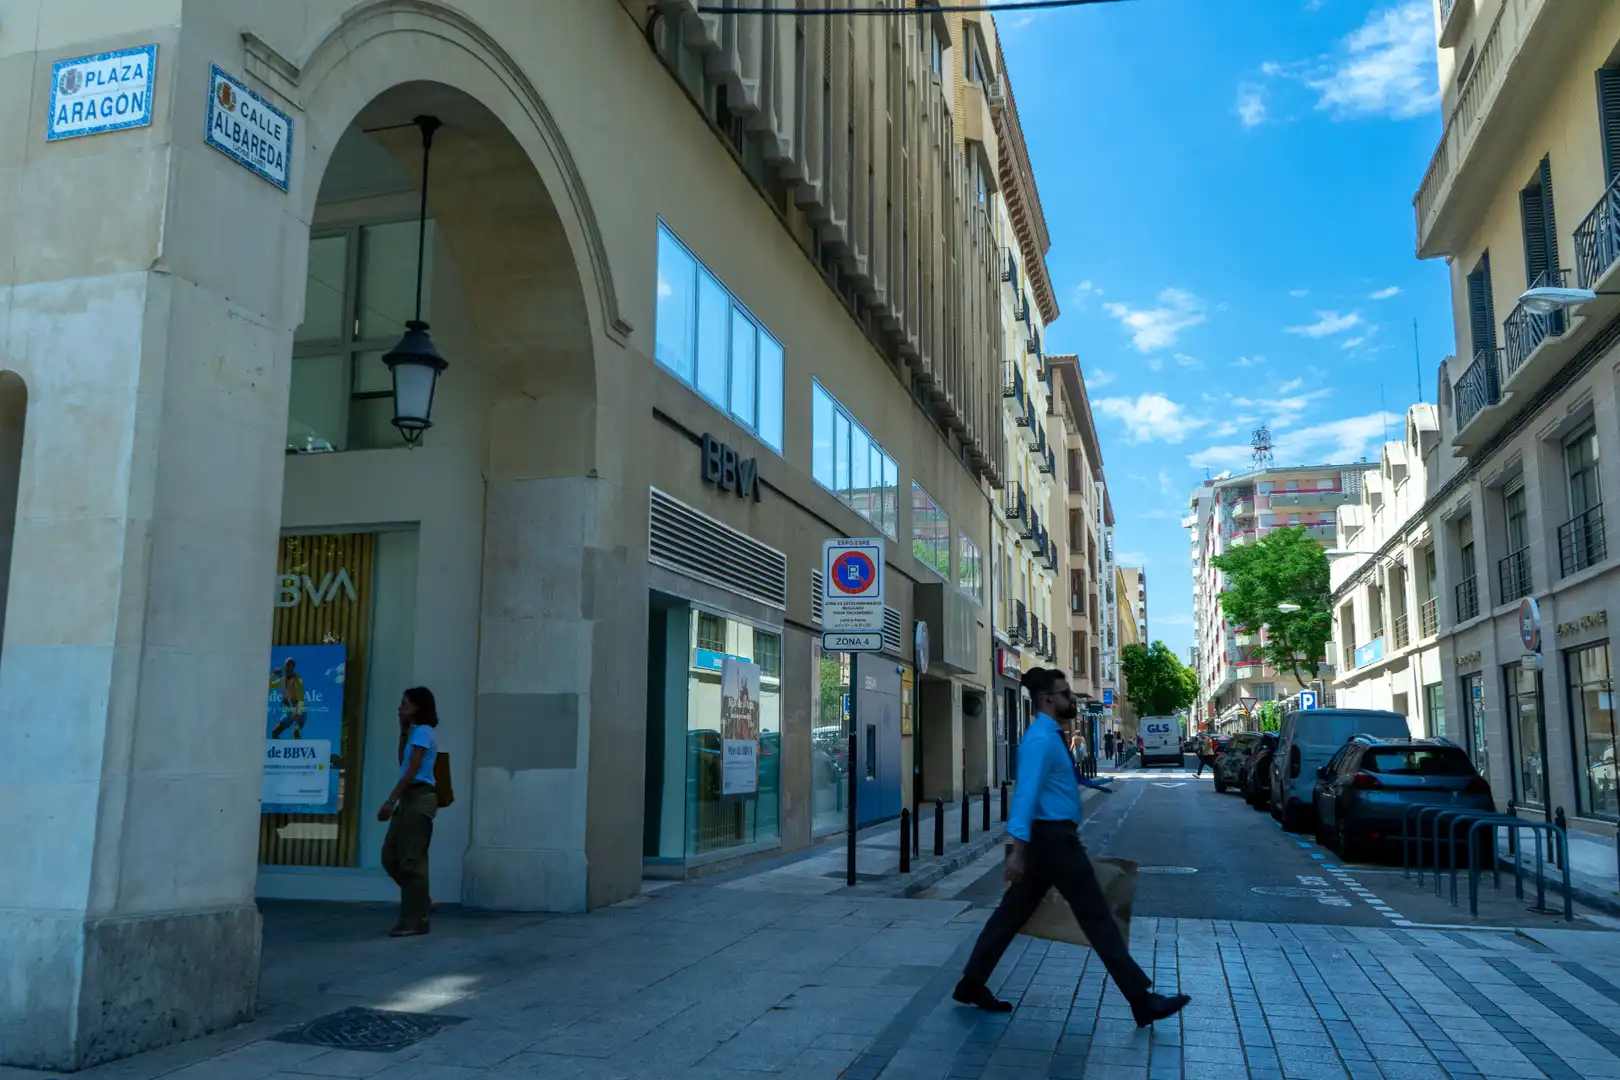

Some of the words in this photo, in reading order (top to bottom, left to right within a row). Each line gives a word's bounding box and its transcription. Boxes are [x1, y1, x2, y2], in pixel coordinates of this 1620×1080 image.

[85, 63, 144, 88] PLAZA
[240, 101, 282, 142] CALLE
[214, 111, 283, 172] ALBAREDA
[701, 432, 761, 503] BBVA
[274, 566, 357, 608] BVA
[304, 690, 323, 702] Ale
[1303, 694, 1313, 710] P
[1147, 724, 1170, 733] GLS
[267, 746, 281, 758] de
[284, 747, 316, 758] BBVA
